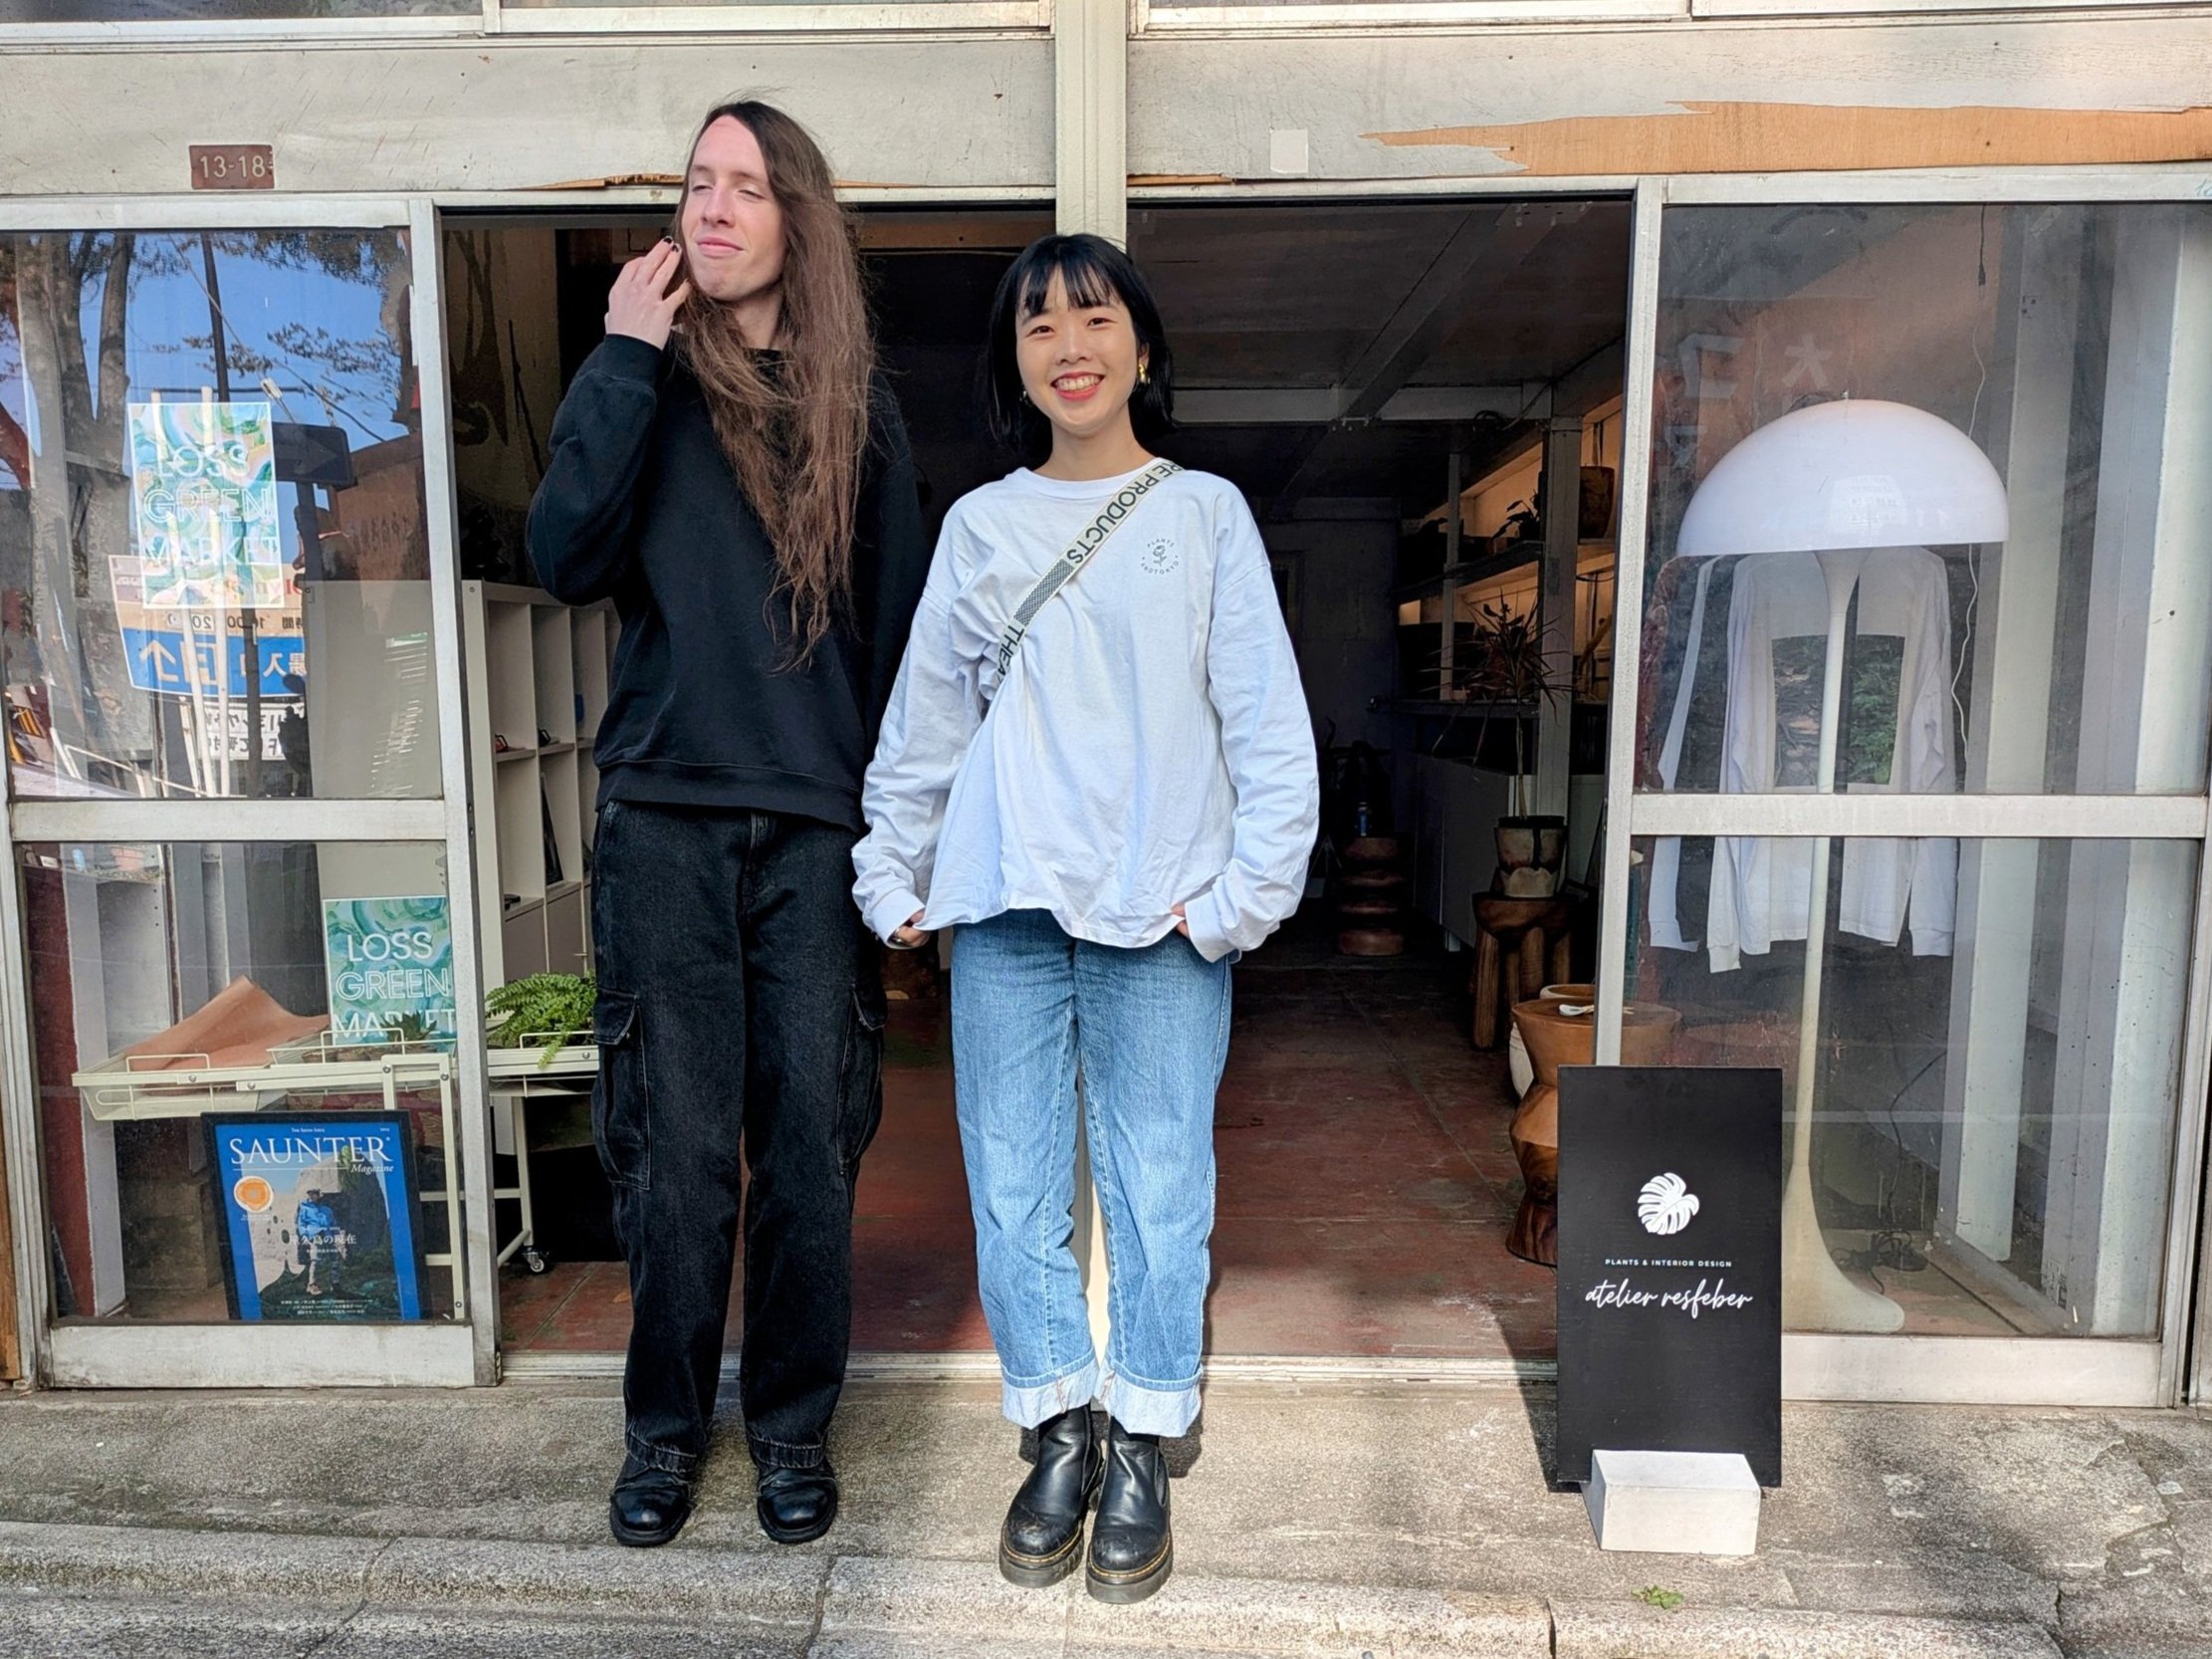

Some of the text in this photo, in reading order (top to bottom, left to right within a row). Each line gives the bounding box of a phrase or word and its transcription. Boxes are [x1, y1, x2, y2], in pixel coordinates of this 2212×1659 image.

[200, 155, 266, 178] 13-18
[156, 444, 249, 478] LOSS
[143, 487, 272, 524] GREEN
[1066, 473, 1159, 565] PRODUCTS
[145, 537, 279, 566] MARKET
[1147, 538, 1176, 549] PLANTS
[347, 931, 433, 962] LOSS
[335, 968, 449, 1002] GREEN
[332, 1009, 456, 1039] MAET
[229, 1136, 394, 1164] SAUNTER
[350, 1163, 395, 1175] Magazine
[1605, 1258, 1639, 1267] PLANTS
[1651, 1259, 1694, 1268] INTERIOR
[1585, 1278, 1754, 1319] atelier resfeber
